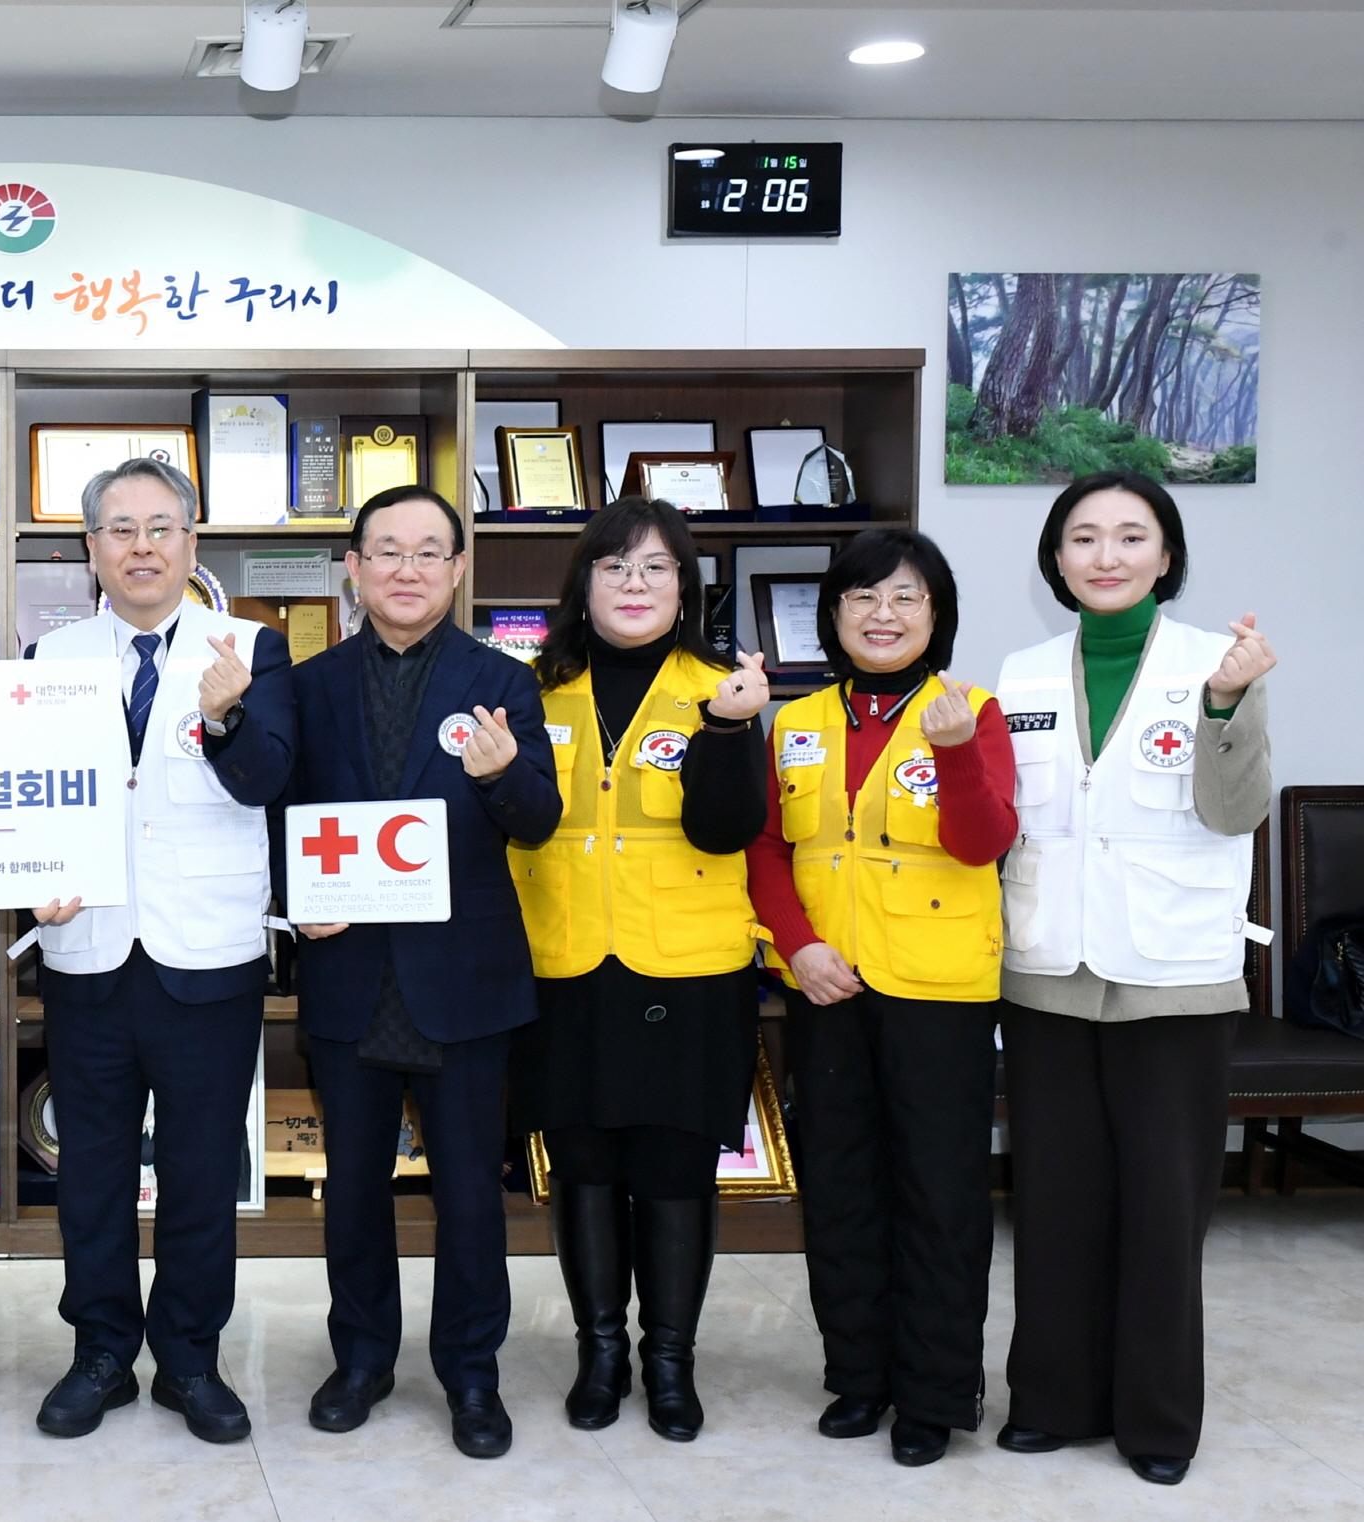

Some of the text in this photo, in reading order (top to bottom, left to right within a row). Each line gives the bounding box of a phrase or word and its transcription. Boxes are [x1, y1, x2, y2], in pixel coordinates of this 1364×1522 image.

[0, 280, 33, 309] 더
[52, 270, 208, 335] 행복한
[225, 278, 338, 322] 구리시
[35, 684, 98, 697] 대한적십자사
[36, 698, 66, 706] 경기도지사
[1007, 713, 1052, 723] 대한적십자사
[1144, 720, 1194, 743] KOREAN RED CROSS
[9, 860, 65, 874] 함께합니다
[305, 892, 433, 903] INTERNATIONAL RED CROSS
[304, 903, 433, 914] AND RED CRESCENT MOVEMENT
[267, 1116, 323, 1129] 一切唯
